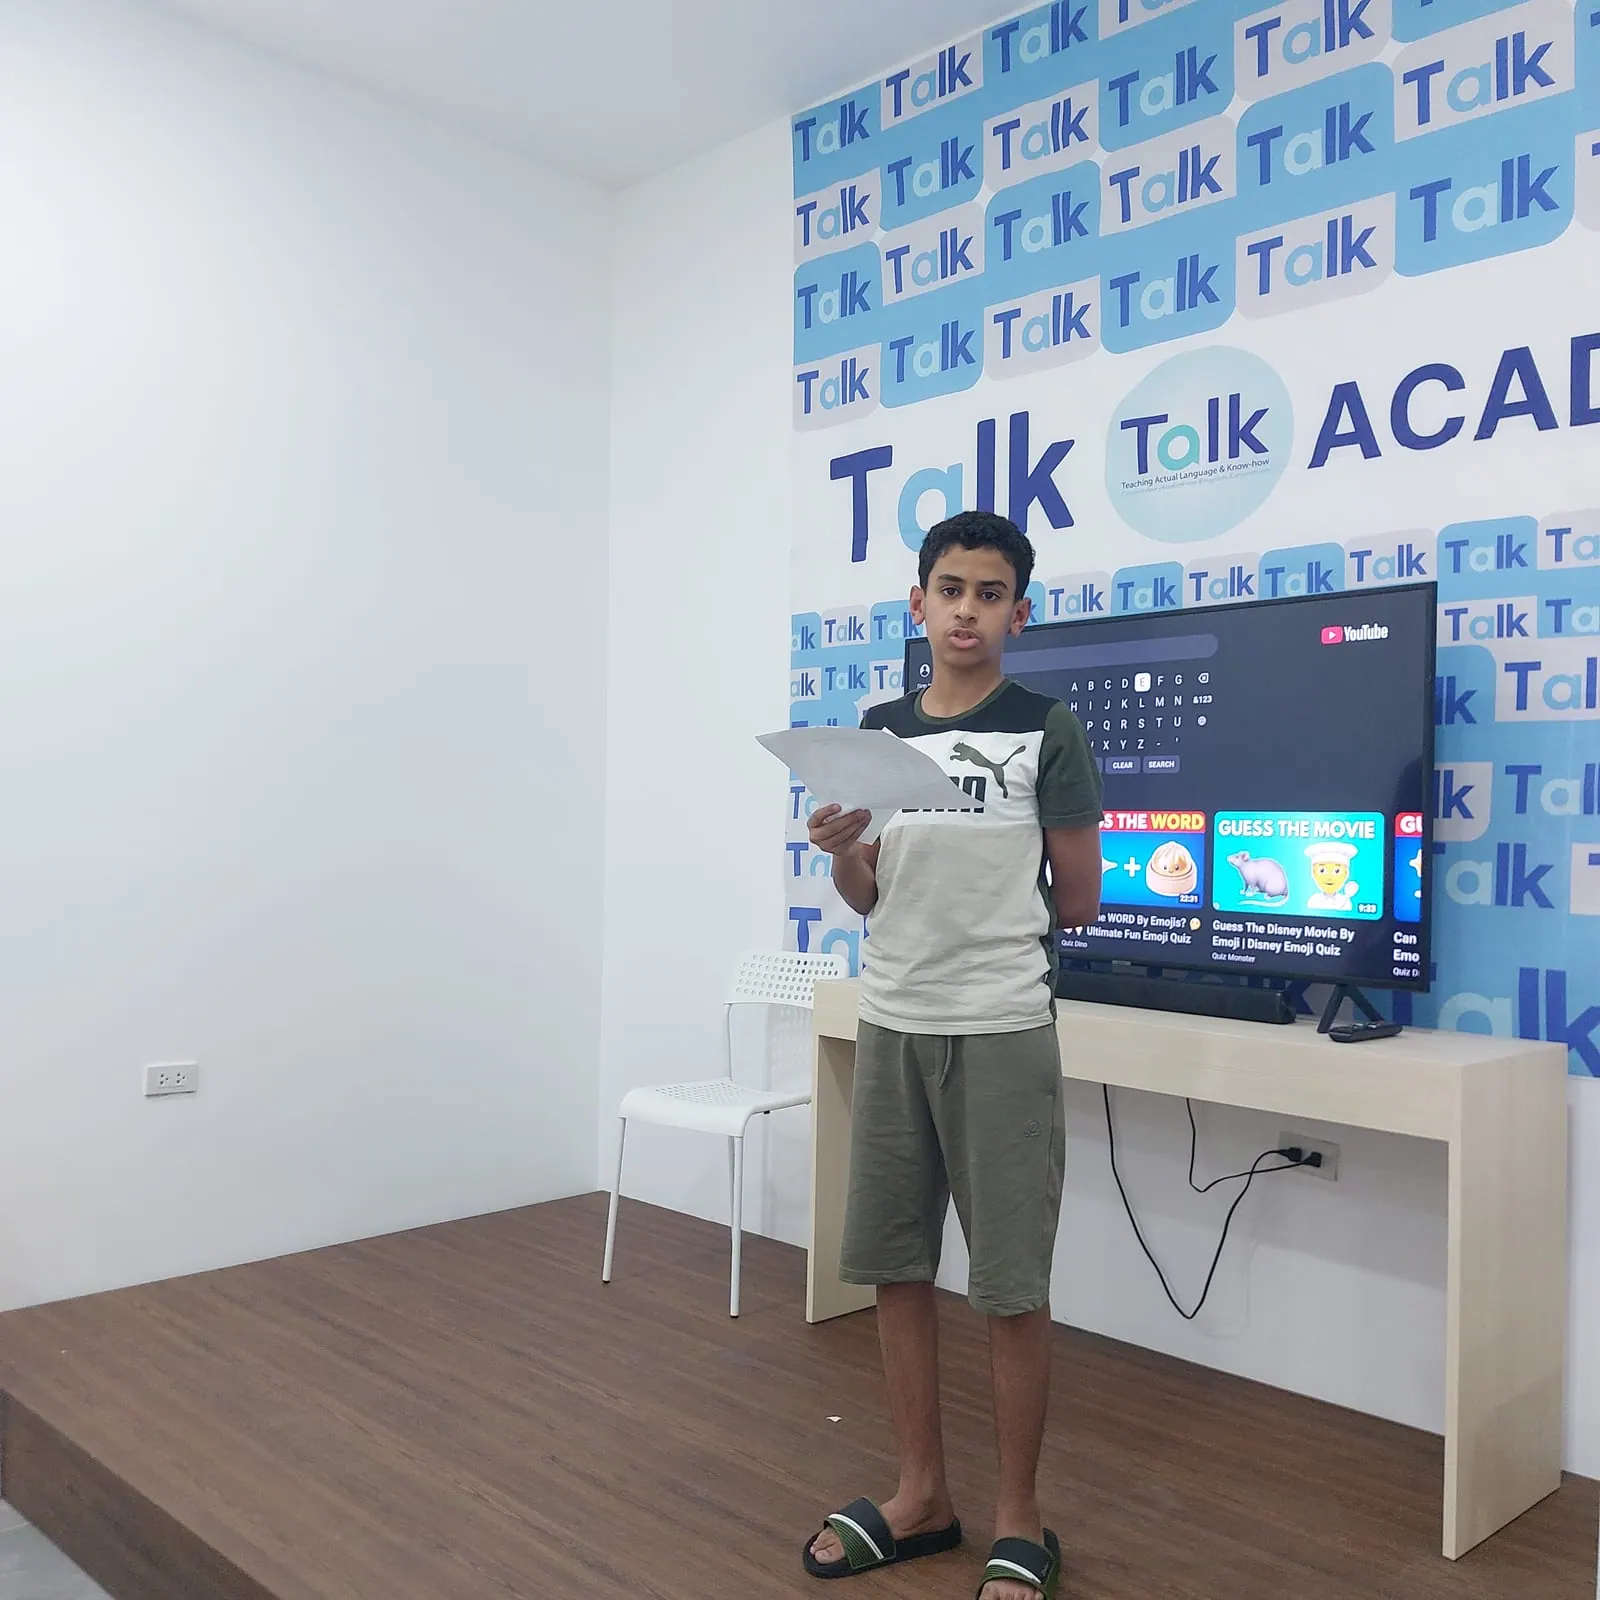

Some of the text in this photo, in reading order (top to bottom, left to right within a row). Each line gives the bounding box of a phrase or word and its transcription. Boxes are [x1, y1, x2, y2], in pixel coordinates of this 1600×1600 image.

[992, 0, 1089, 73] Talk
[1245, 0, 1375, 77] Talk
[885, 45, 973, 118] Talk
[1109, 46, 1219, 127] Talk
[1403, 31, 1556, 126] Talk
[795, 100, 870, 162] Talk
[992, 97, 1090, 170] Talk
[1247, 101, 1376, 186] Talk
[887, 136, 975, 206] Talk
[1109, 144, 1223, 224] Talk
[796, 185, 871, 247] Talk
[1409, 154, 1560, 243] Talk
[994, 190, 1090, 261] Talk
[885, 227, 975, 294] Talk
[1247, 214, 1378, 296] Talk
[797, 270, 872, 329] Talk
[1109, 253, 1220, 328] Talk
[993, 292, 1092, 359] Talk
[890, 320, 976, 383] Talk
[797, 357, 870, 414] Talk
[1120, 392, 1270, 475] Talk
[830, 410, 1075, 562] Talk
[1121, 478, 1153, 490] Teaching
[1154, 472, 1179, 485] Actual
[1179, 466, 1218, 481] Language
[1219, 465, 1226, 474] &
[1226, 458, 1270, 473] Know-how
[1350, 543, 1427, 582] Talk
[1445, 534, 1528, 573] Talk
[1117, 577, 1176, 611] Talk
[1189, 565, 1255, 601] Talk
[1265, 561, 1334, 597] Talk
[1049, 583, 1104, 616] Talk
[824, 615, 865, 643] Talk
[1344, 623, 1389, 642] YouTube
[1445, 603, 1529, 641] Talk
[825, 664, 866, 691] Talk
[1071, 682, 1078, 692] A
[1088, 681, 1095, 691] B
[1104, 680, 1112, 690] C
[1121, 678, 1129, 689] D
[1157, 676, 1164, 686] F
[1174, 674, 1183, 685] G
[1070, 702, 1078, 712] H
[1104, 700, 1111, 710] J
[1121, 699, 1128, 709] K
[1139, 698, 1145, 708] L
[1155, 696, 1165, 707] M
[1174, 696, 1182, 706] N
[1087, 716, 1181, 731] P Q R S T U
[1103, 740, 1110, 751] X
[1120, 740, 1127, 750] Y
[1137, 739, 1144, 750] Z
[1112, 761, 1133, 769] CLEAR
[1148, 760, 1175, 769] SEARCH
[1116, 813, 1148, 829] THE
[1150, 813, 1205, 830] WORD
[1218, 819, 1376, 839] GUESS THE MOVIE
[1432, 842, 1555, 909] alk
[1086, 925, 1192, 944] Ultimate Fun Emoji Quiz
[1107, 913, 1135, 924] WORD
[1137, 915, 1149, 927] By
[1150, 916, 1187, 930] Emojis?
[1212, 920, 1355, 942] Guess The Disney Movie By
[1393, 931, 1417, 945] Can
[1061, 939, 1074, 947] Quiz
[1211, 952, 1256, 963] Quiz Monster
[1212, 935, 1241, 950] Emoji
[1247, 938, 1282, 954] Disney
[1283, 940, 1314, 956] Emoji
[1315, 943, 1341, 957] Quiz
[1393, 948, 1420, 964] Emo
[1392, 967, 1411, 977] Quiz
